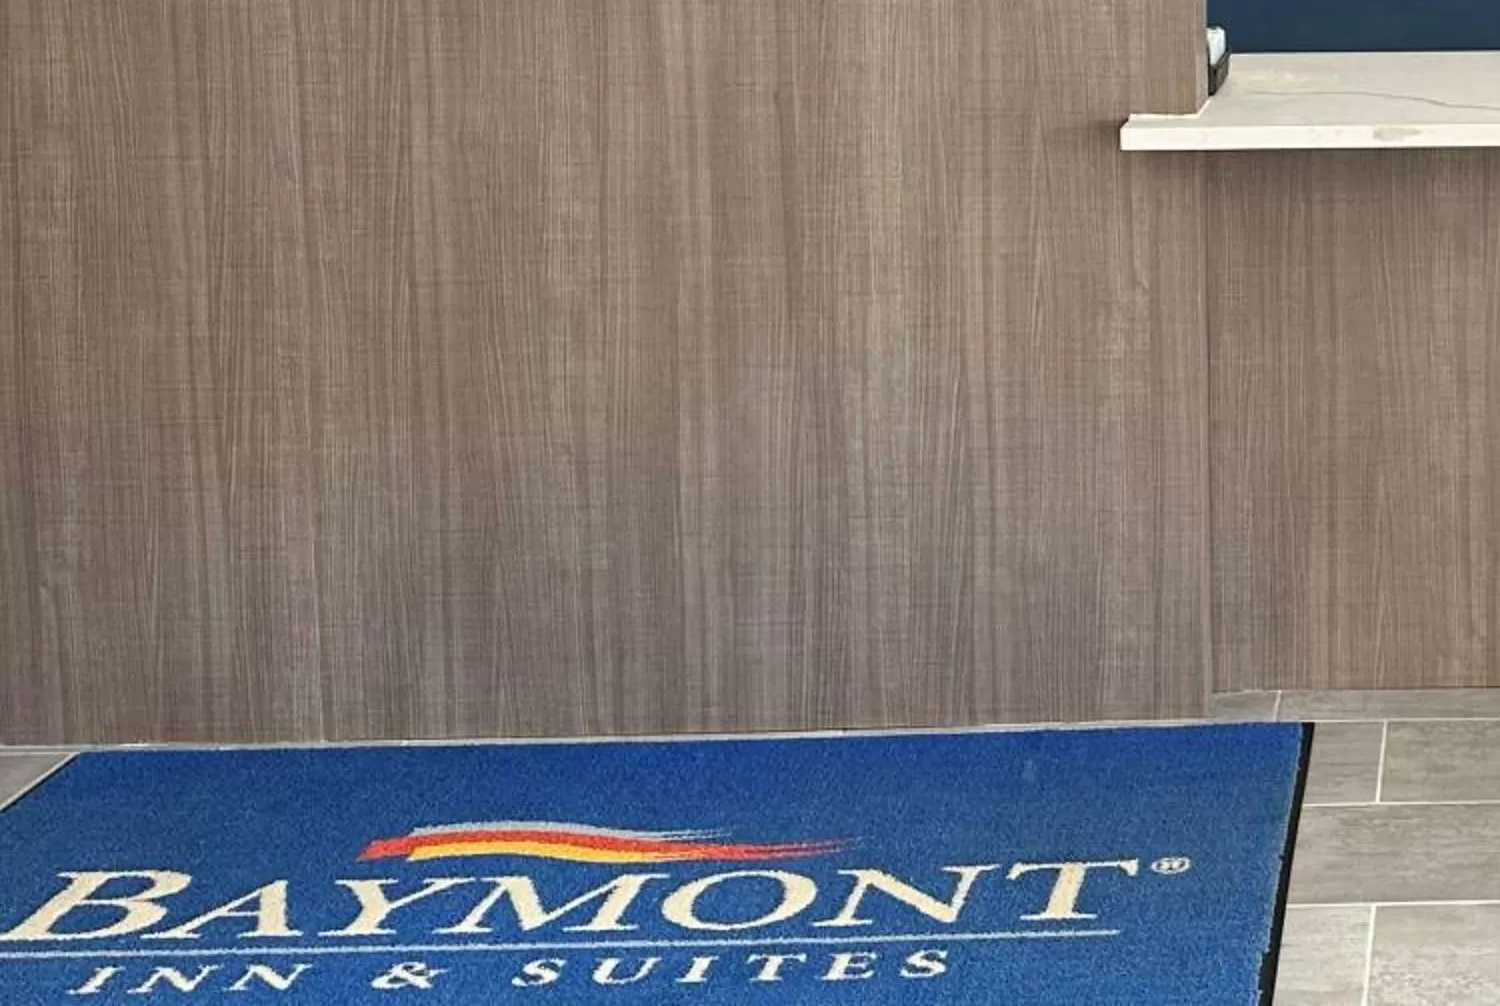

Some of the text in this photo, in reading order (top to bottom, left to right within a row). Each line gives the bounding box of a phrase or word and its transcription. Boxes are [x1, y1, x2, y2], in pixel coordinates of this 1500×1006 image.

[68, 949, 950, 995] INN & SUITES
